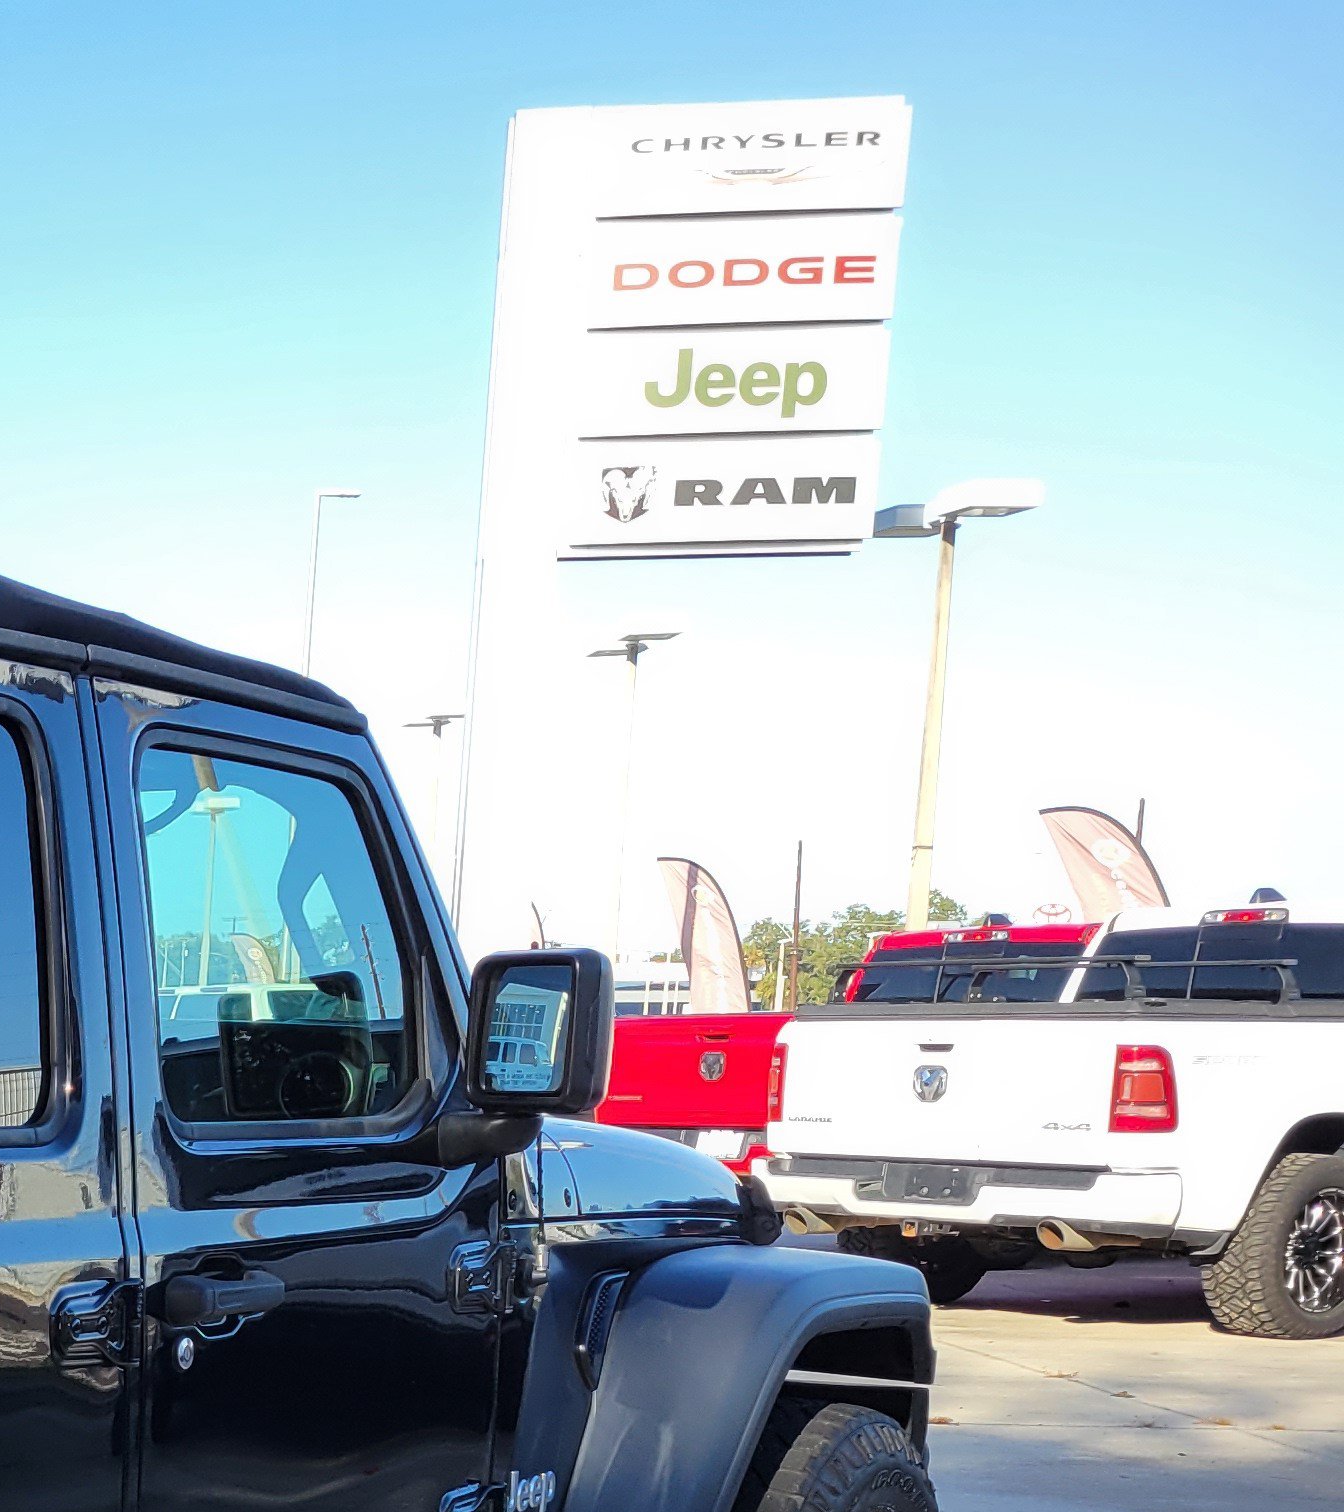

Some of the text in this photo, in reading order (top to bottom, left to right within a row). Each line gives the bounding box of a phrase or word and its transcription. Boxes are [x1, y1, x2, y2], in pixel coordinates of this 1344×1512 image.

[631, 131, 881, 153] CHRYSLER
[613, 255, 877, 291] DODGE
[644, 348, 827, 418] Jeep
[674, 476, 857, 506] RAM
